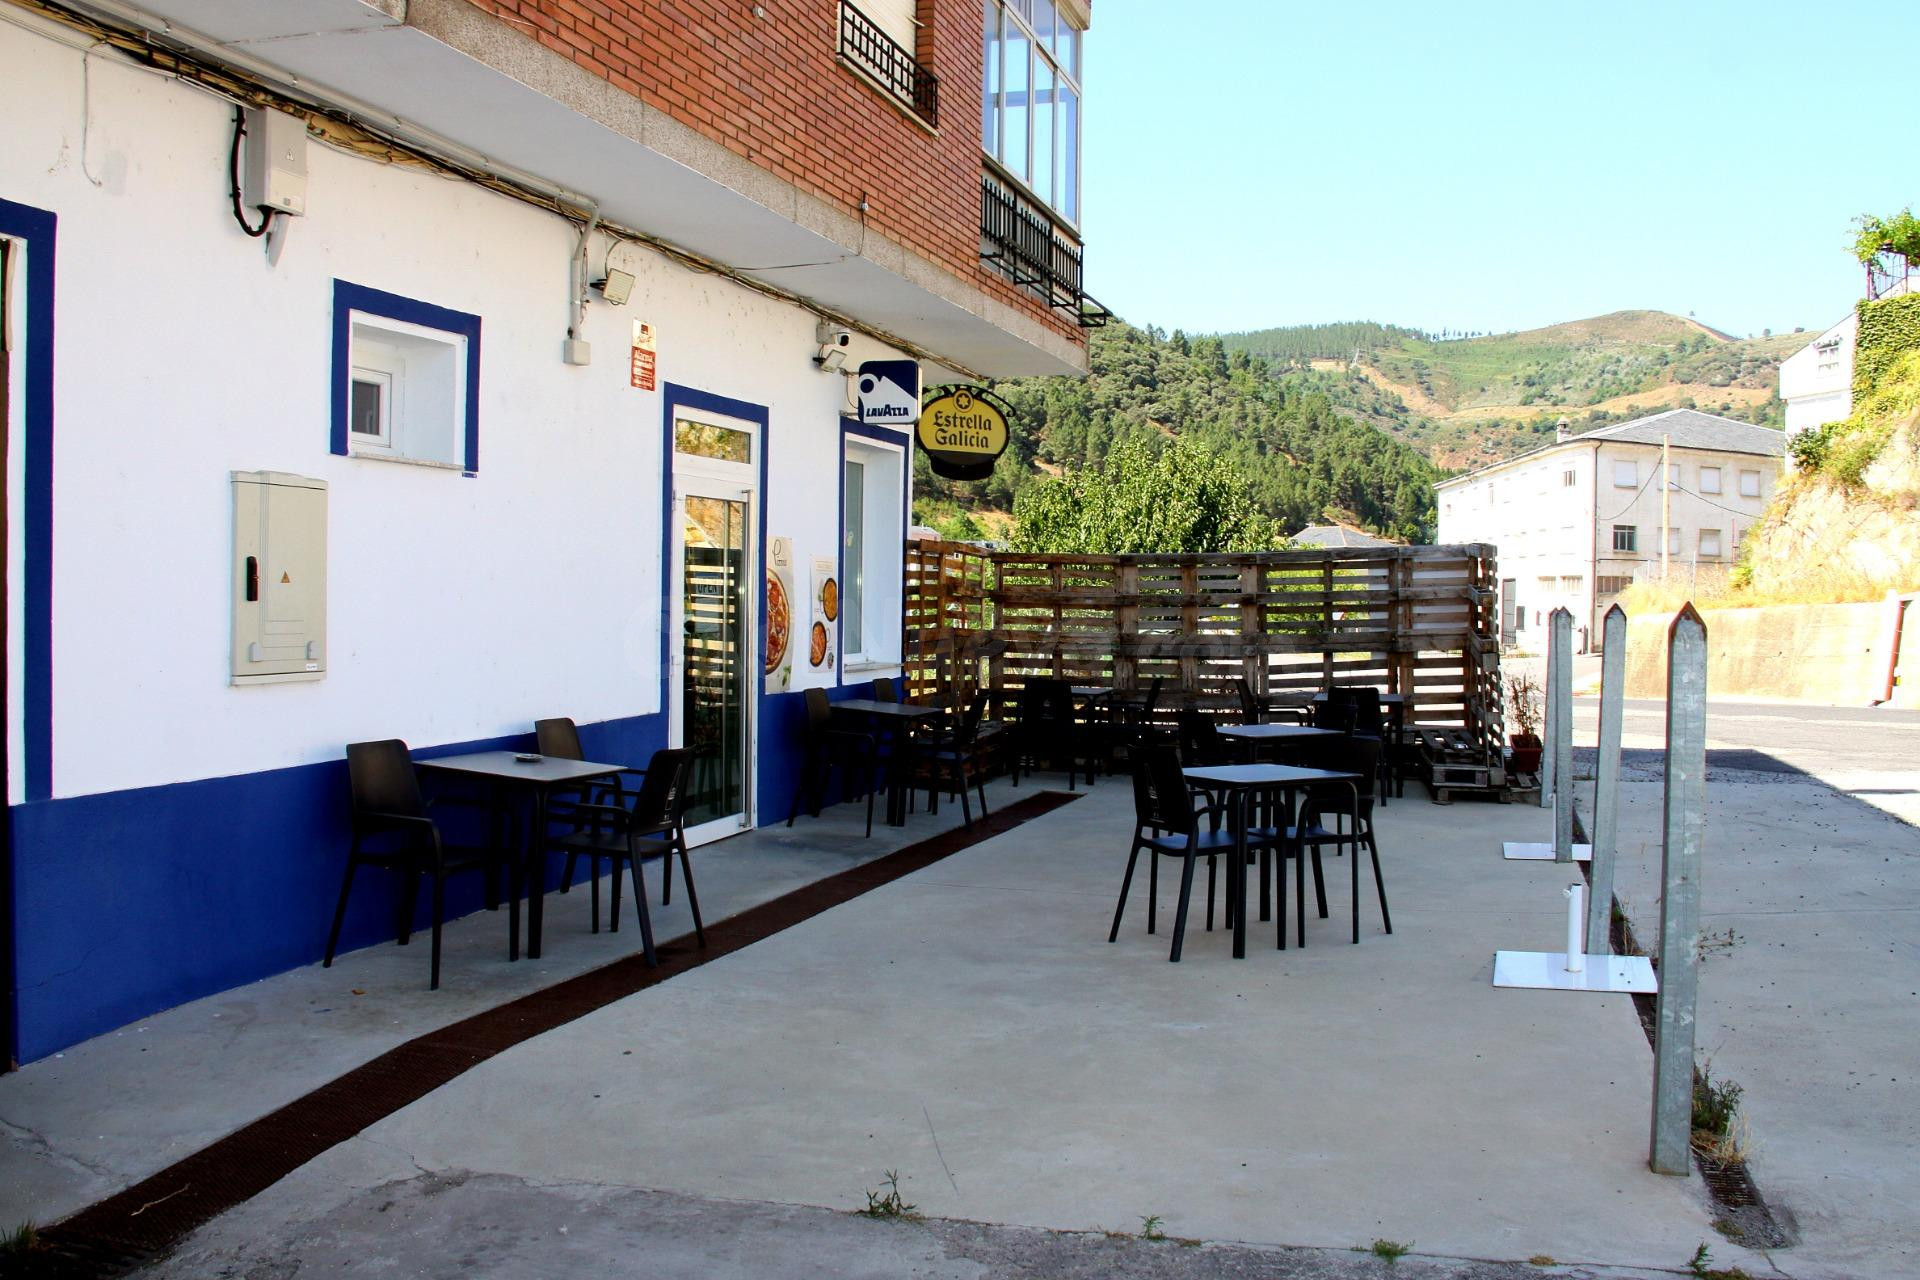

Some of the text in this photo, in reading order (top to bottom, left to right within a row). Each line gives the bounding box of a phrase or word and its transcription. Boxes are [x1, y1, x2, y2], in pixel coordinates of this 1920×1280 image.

[865, 404, 909, 417] LAVAZZA
[933, 410, 992, 431] Estrella
[935, 428, 989, 448] Galicia
